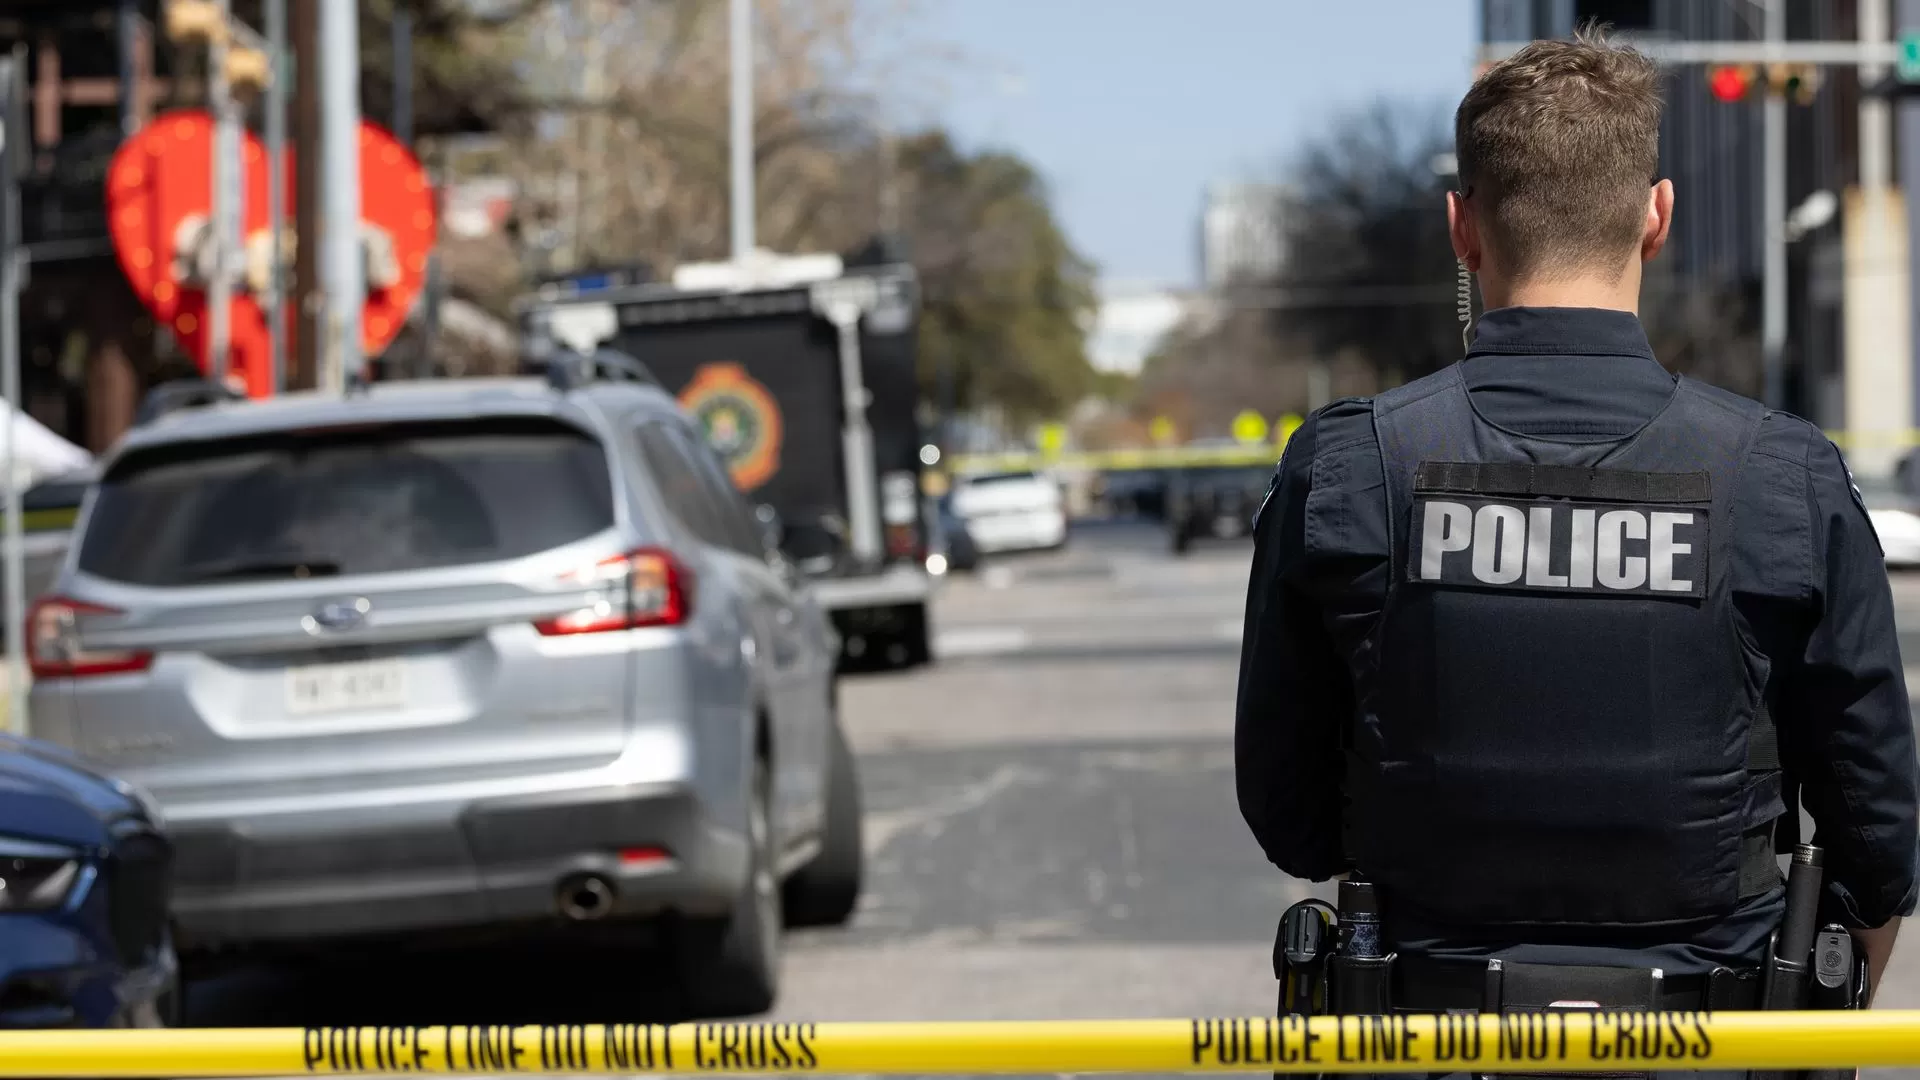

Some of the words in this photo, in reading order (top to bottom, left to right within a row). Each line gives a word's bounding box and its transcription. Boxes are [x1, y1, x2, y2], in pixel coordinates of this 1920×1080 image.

[1421, 501, 1693, 592] POLICE
[304, 1025, 430, 1071] POLICE
[446, 1025, 525, 1070] LINE
[541, 1024, 590, 1070] DO
[603, 1023, 677, 1070] NOT
[695, 1022, 817, 1070] CROSS
[1192, 1016, 1322, 1065] POLICE
[1337, 1015, 1419, 1064] LINE
[1434, 1013, 1481, 1062] DO
[1498, 1012, 1570, 1061] NOT
[1588, 1011, 1713, 1060] CROSS
